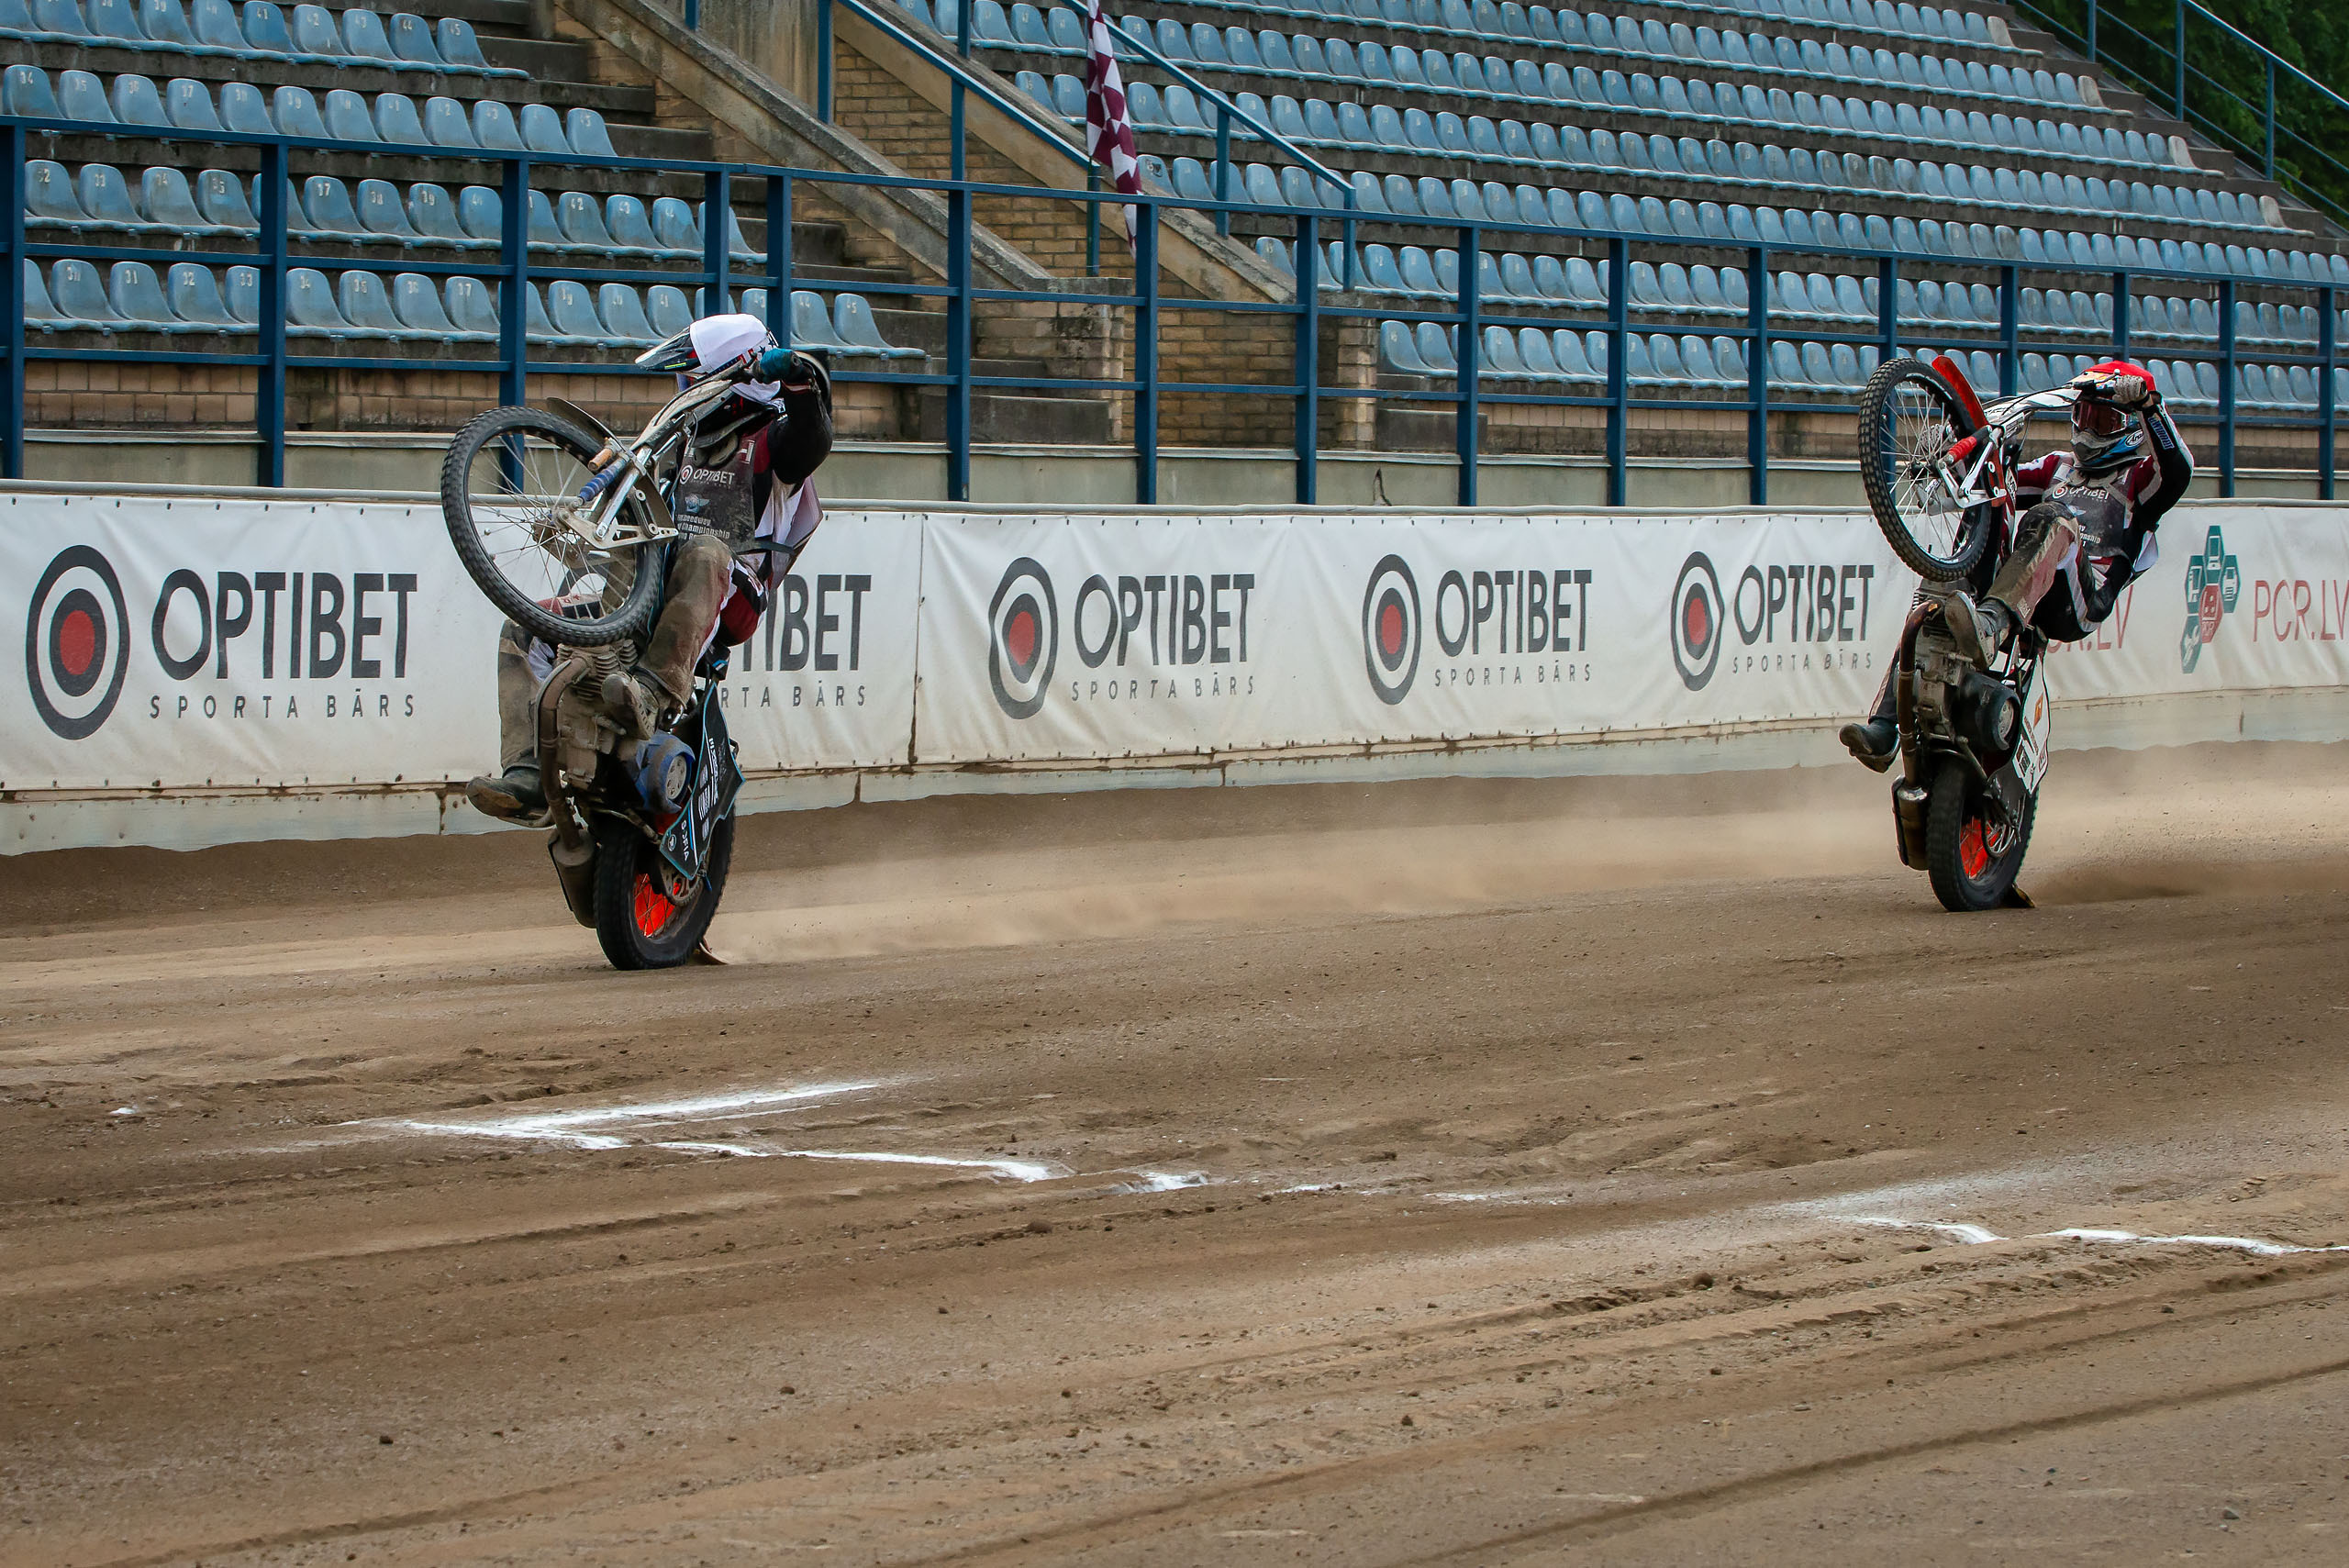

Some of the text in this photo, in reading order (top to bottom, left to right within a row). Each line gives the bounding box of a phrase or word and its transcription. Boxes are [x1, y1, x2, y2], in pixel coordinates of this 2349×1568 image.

[20, 71, 34, 84] 34
[317, 183, 331, 197] 37
[420, 190, 436, 206] 39
[570, 196, 584, 211] 42
[125, 269, 139, 284] 31
[183, 271, 196, 286] 32
[239, 272, 253, 287] 33
[353, 278, 368, 294] 35
[458, 282, 473, 297] 37
[693, 468, 736, 485] OPTIBET
[1435, 569, 1593, 658] OPTIBET
[1734, 564, 1875, 646] OPTIBET
[2253, 579, 2349, 642] PCR.LV
[152, 568, 418, 680] OPTIBET
[742, 573, 873, 672] IBET
[1074, 573, 1255, 669] OPTIBET
[1434, 659, 1591, 687] SPORTA BĀRS
[1732, 648, 1872, 674] SPORTA BĀRS
[720, 680, 865, 708] RTA BĀRS
[1072, 672, 1254, 702] SPORTA BĀRS
[150, 688, 415, 718] SPORTA BĀRS
